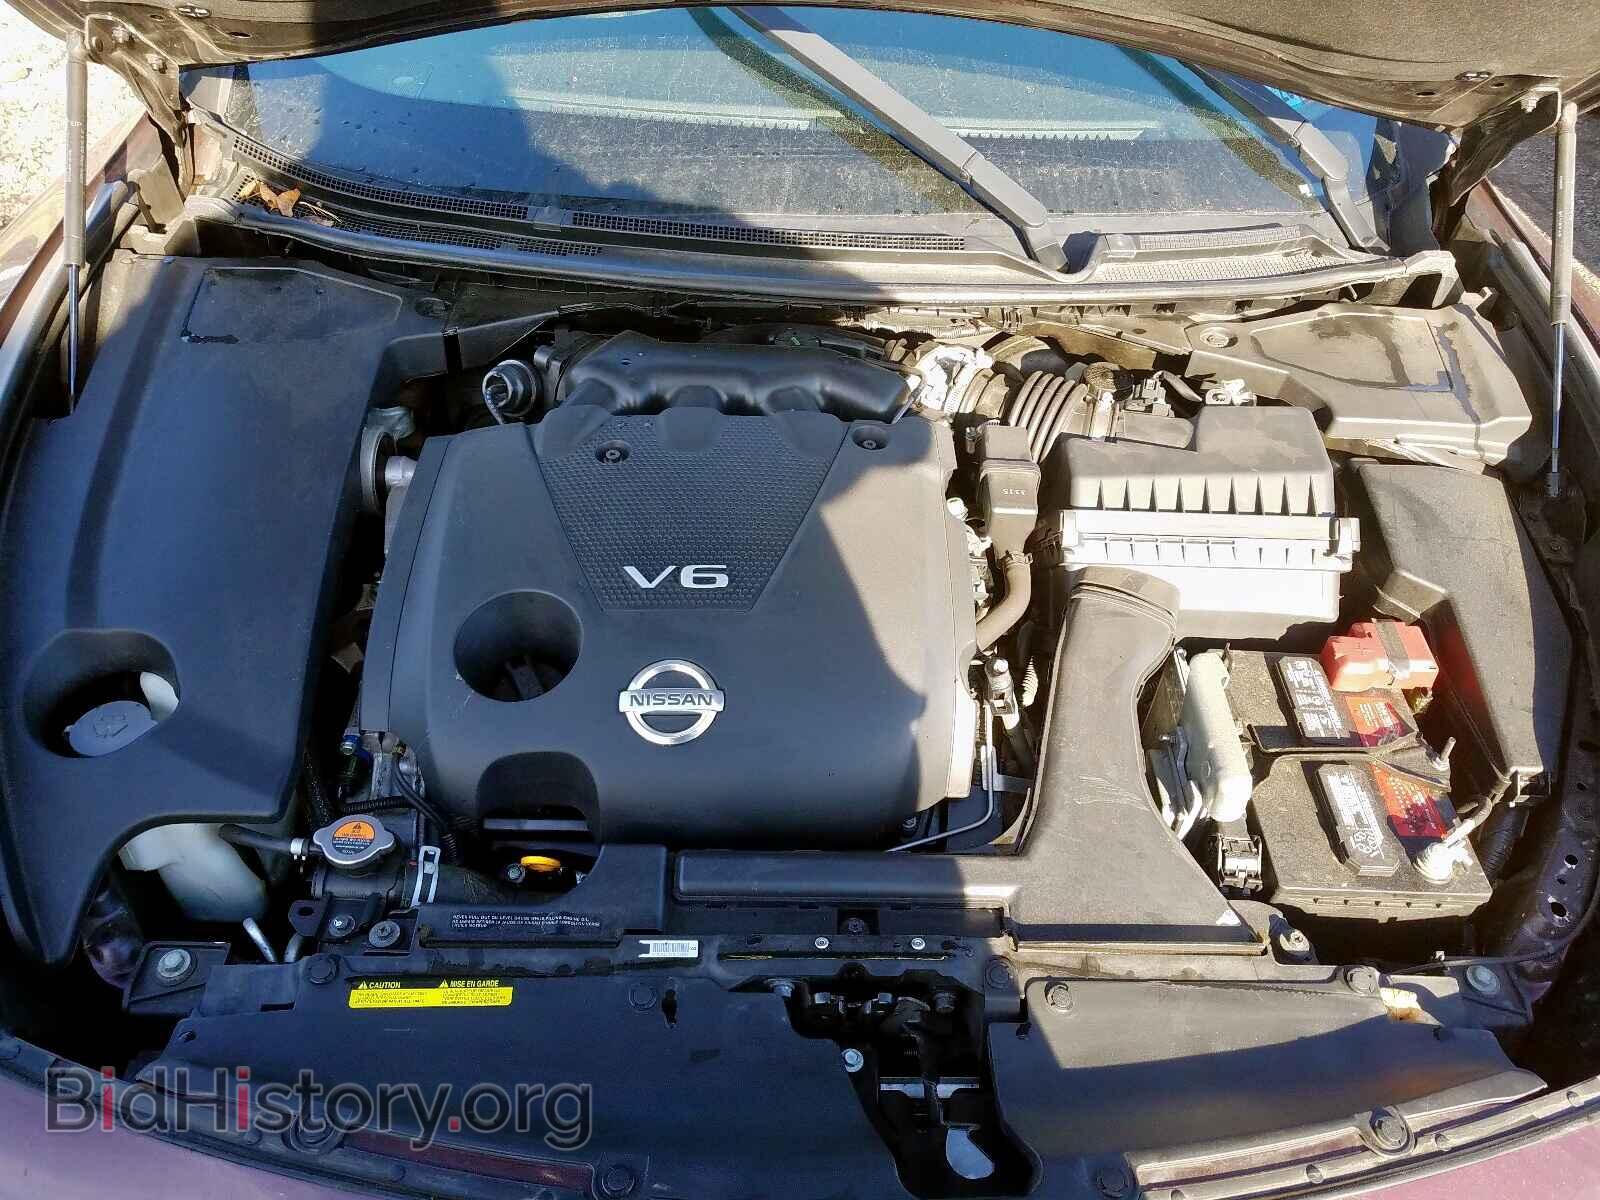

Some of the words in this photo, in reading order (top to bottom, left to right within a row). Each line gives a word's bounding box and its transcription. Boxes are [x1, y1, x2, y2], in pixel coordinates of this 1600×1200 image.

[622, 564, 729, 589] V6
[630, 693, 713, 707] NISSAN
[368, 981, 401, 989] CAUTION
[450, 980, 466, 988] MISE
[466, 980, 476, 988] EN
[476, 980, 500, 988] GARDE
